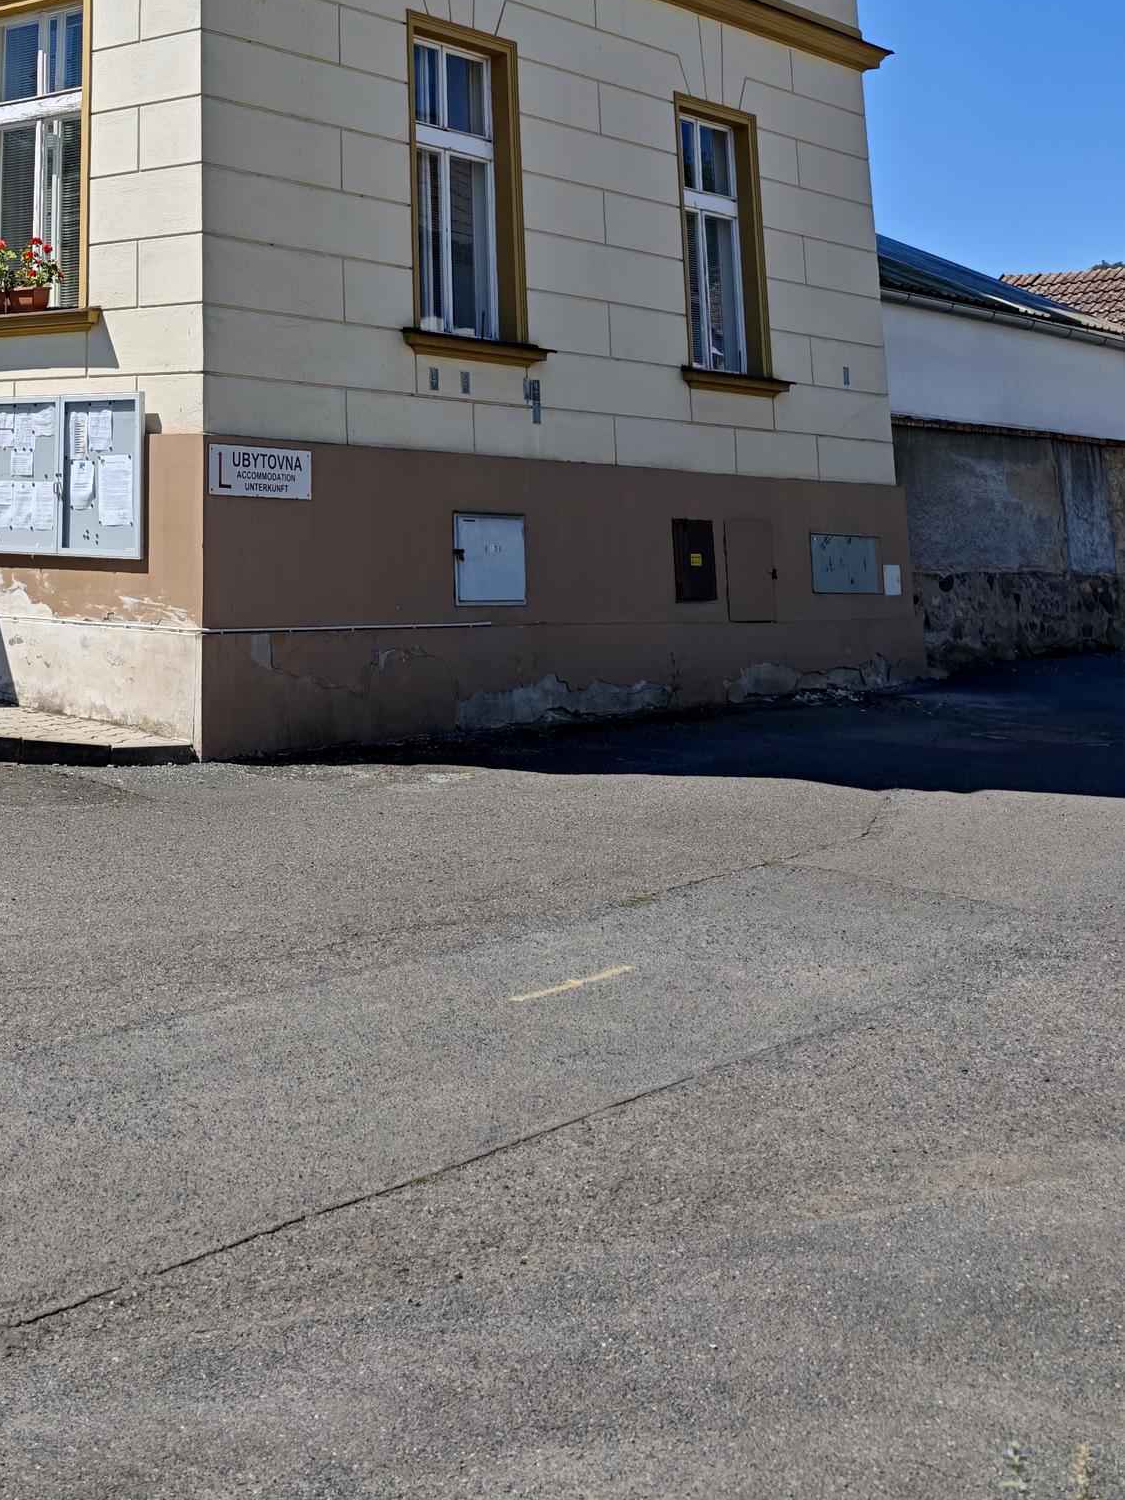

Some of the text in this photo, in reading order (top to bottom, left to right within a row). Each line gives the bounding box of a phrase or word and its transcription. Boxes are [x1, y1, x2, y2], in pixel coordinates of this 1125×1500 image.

[232, 451, 302, 471] UBYTOVNA
[236, 470, 296, 482] ACCOMMODATION
[245, 482, 288, 492] UNTERKUNFT
